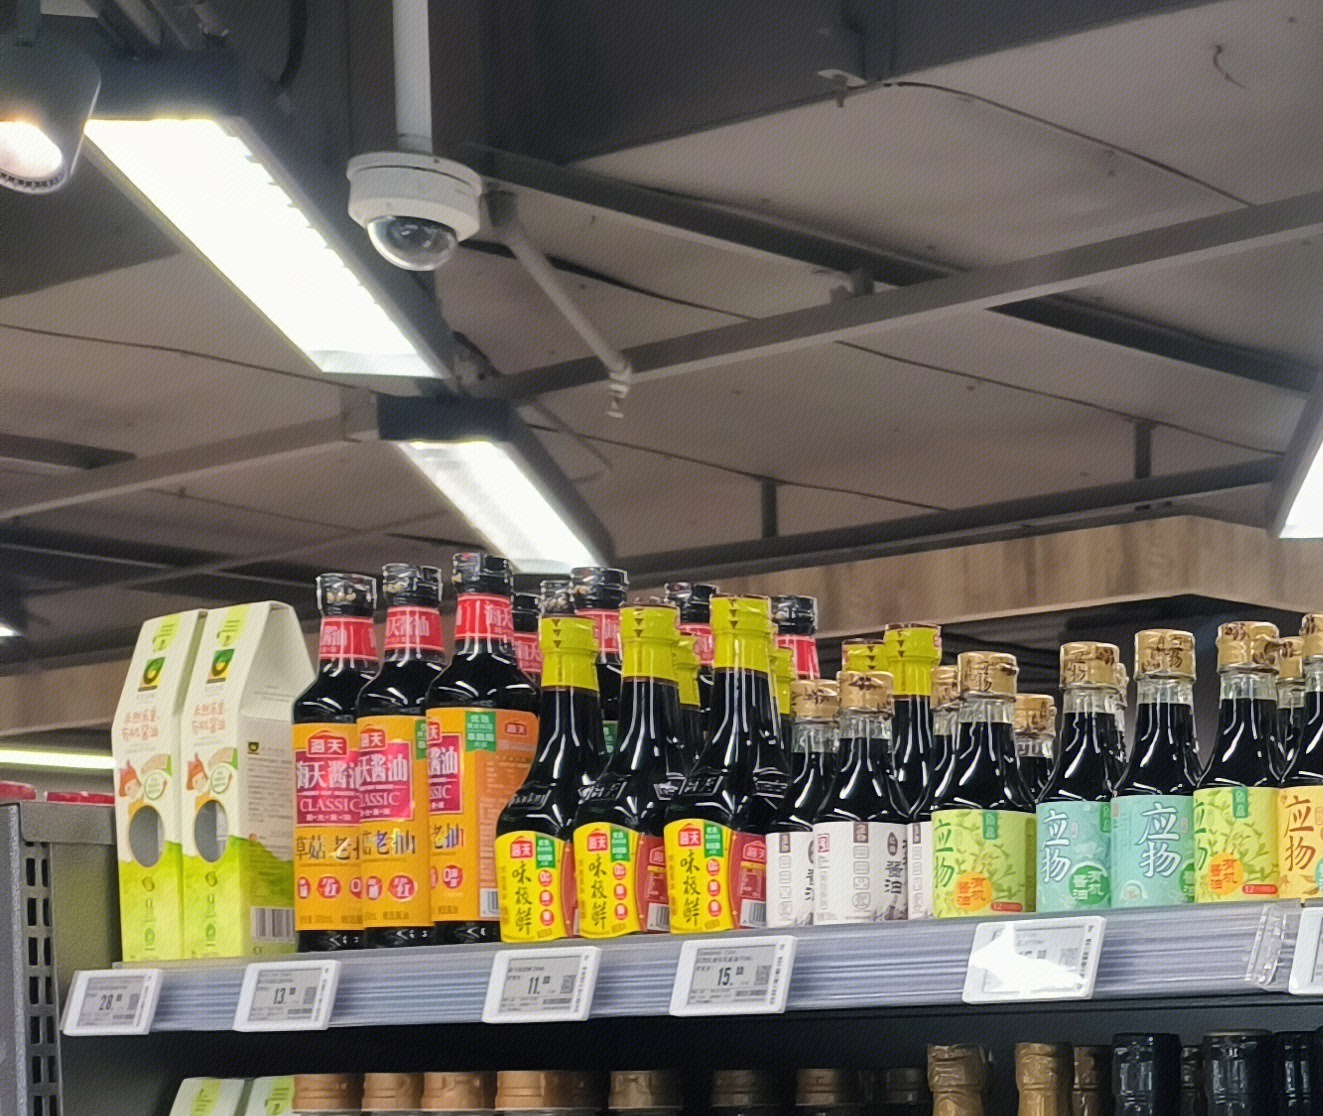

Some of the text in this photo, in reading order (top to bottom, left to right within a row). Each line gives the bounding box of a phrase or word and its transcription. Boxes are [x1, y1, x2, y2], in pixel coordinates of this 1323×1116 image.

[309, 740, 345, 754] 海天
[1042, 809, 1072, 883] 应物
[1139, 802, 1183, 878] 应物
[1283, 795, 1316, 873] 应物
